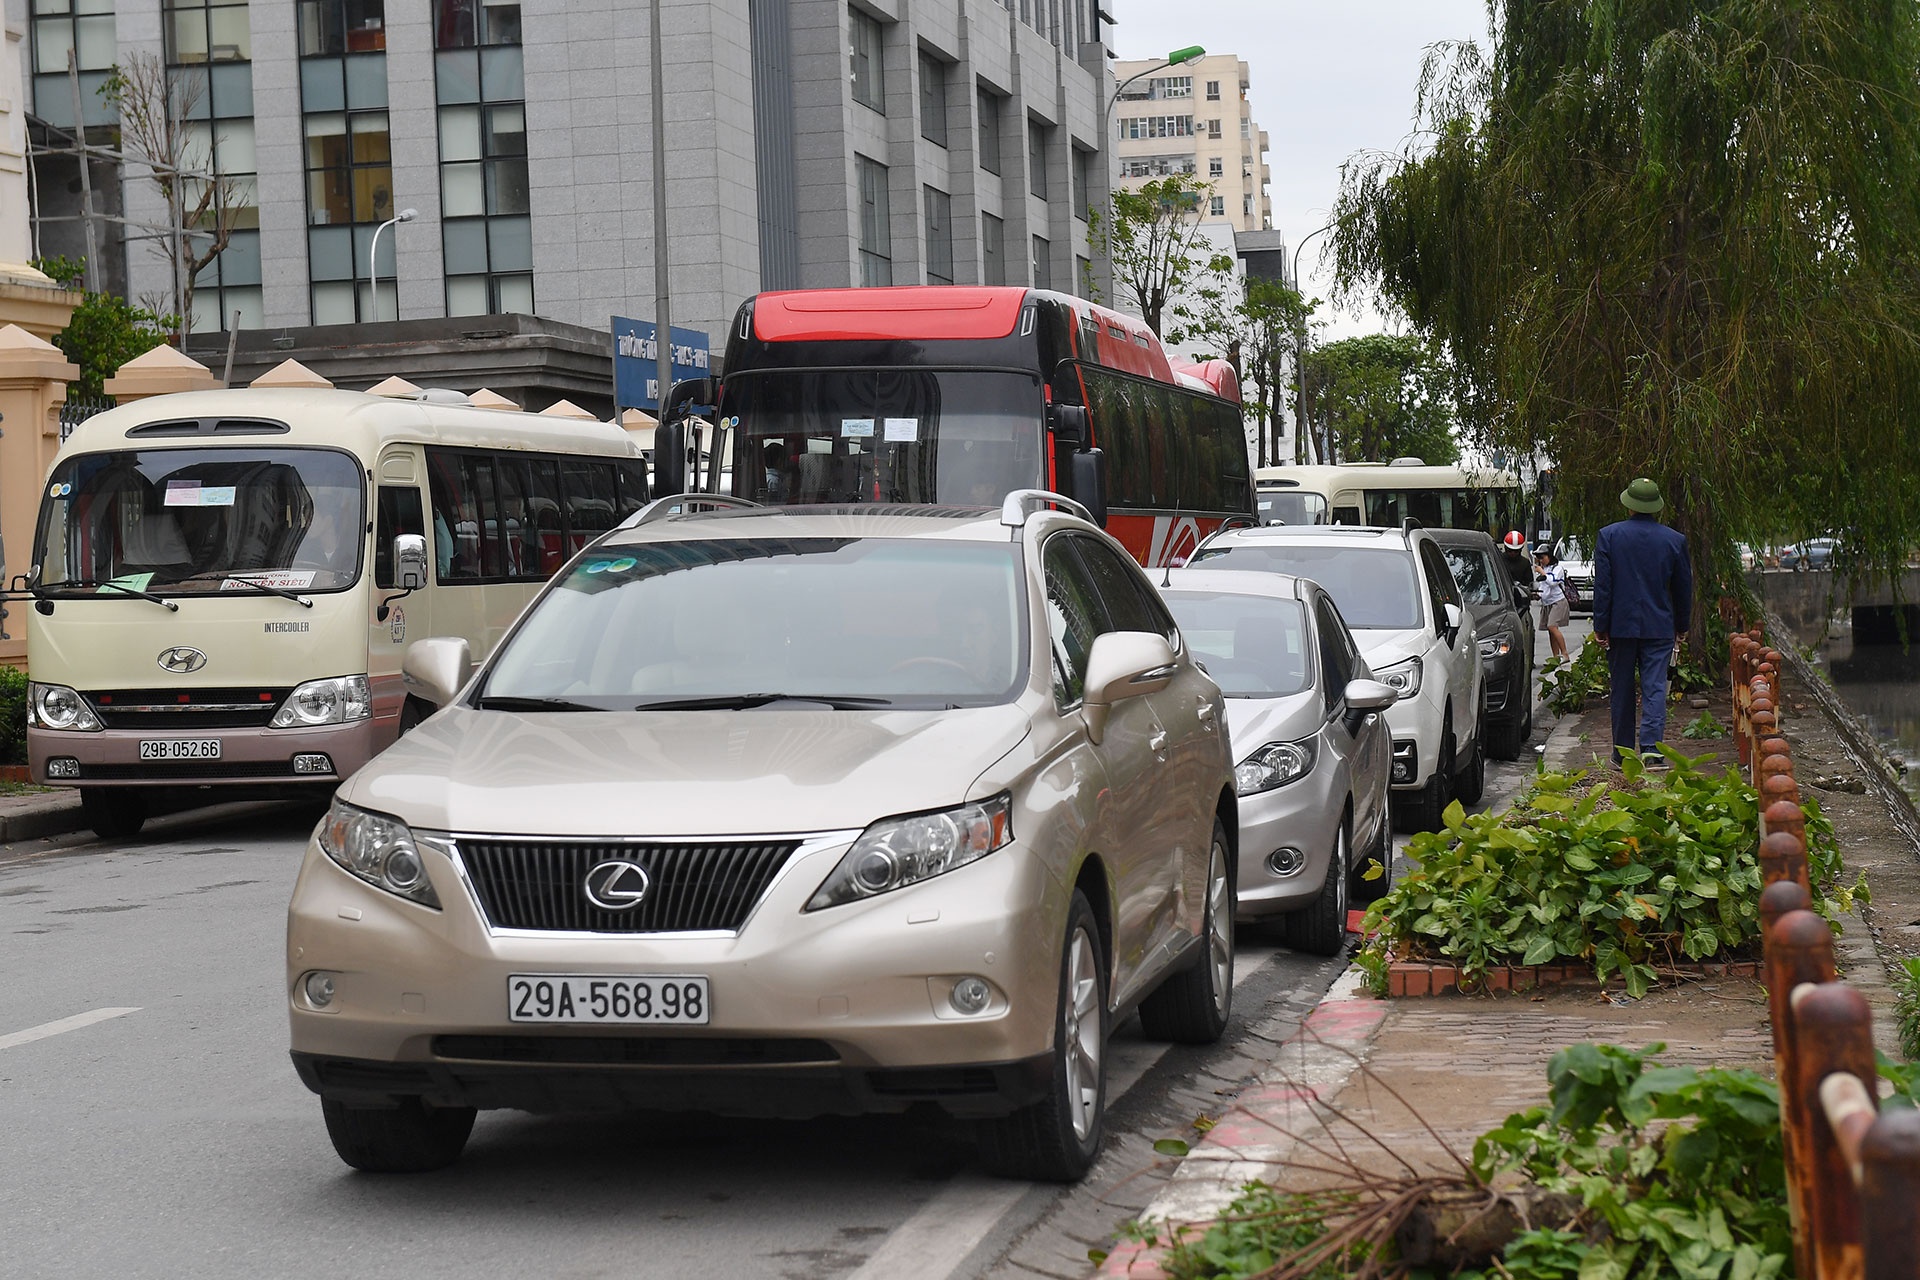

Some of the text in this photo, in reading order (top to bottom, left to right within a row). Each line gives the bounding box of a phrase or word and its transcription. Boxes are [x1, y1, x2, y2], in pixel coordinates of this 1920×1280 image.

[264, 621, 309, 633] INTERCOOLER
[142, 741, 218, 758] 29B-052.66
[514, 980, 702, 1019] 29A-568.98
